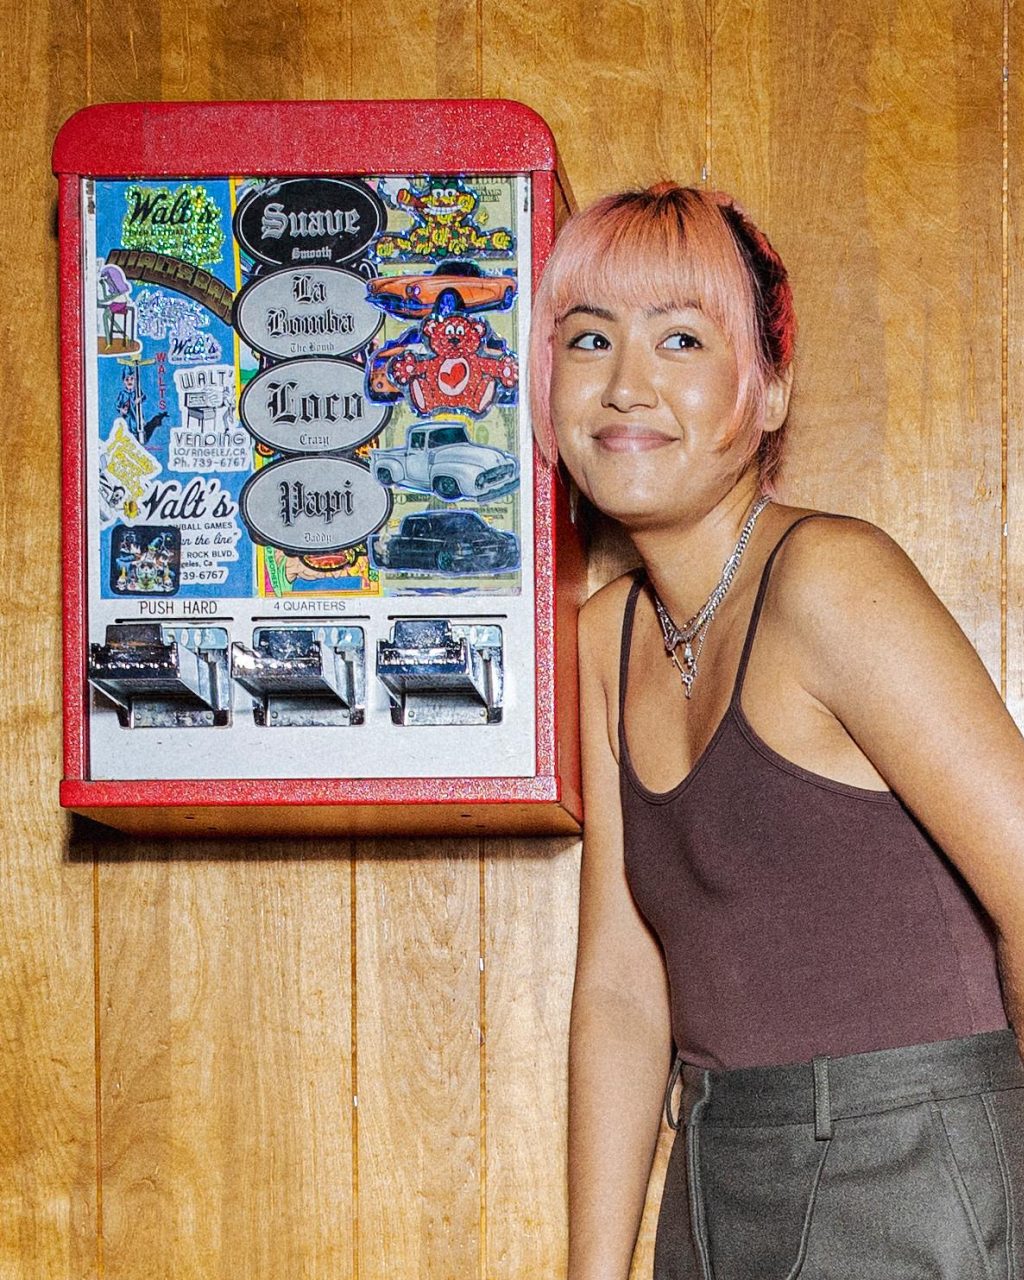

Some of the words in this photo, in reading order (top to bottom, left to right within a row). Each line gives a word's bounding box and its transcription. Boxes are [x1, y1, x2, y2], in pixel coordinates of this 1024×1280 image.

[261, 202, 361, 240] Suave
[291, 246, 333, 261] Smooth
[292, 274, 327, 304] La
[266, 307, 356, 338] Bomba
[290, 342, 307, 354] The
[266, 380, 363, 426] Loco
[299, 433, 330, 447] Crazy
[192, 457, 246, 468] 739-6767
[279, 479, 354, 527] Papi
[204, 522, 233, 530] GAMES
[194, 534, 211, 546] the
[304, 533, 333, 545] Daddy
[187, 551, 209, 559] ROCK
[140, 600, 174, 615] PUSH
[183, 600, 218, 615] HARD
[273, 602, 280, 611] 4
[283, 601, 346, 612] QUARTERS
